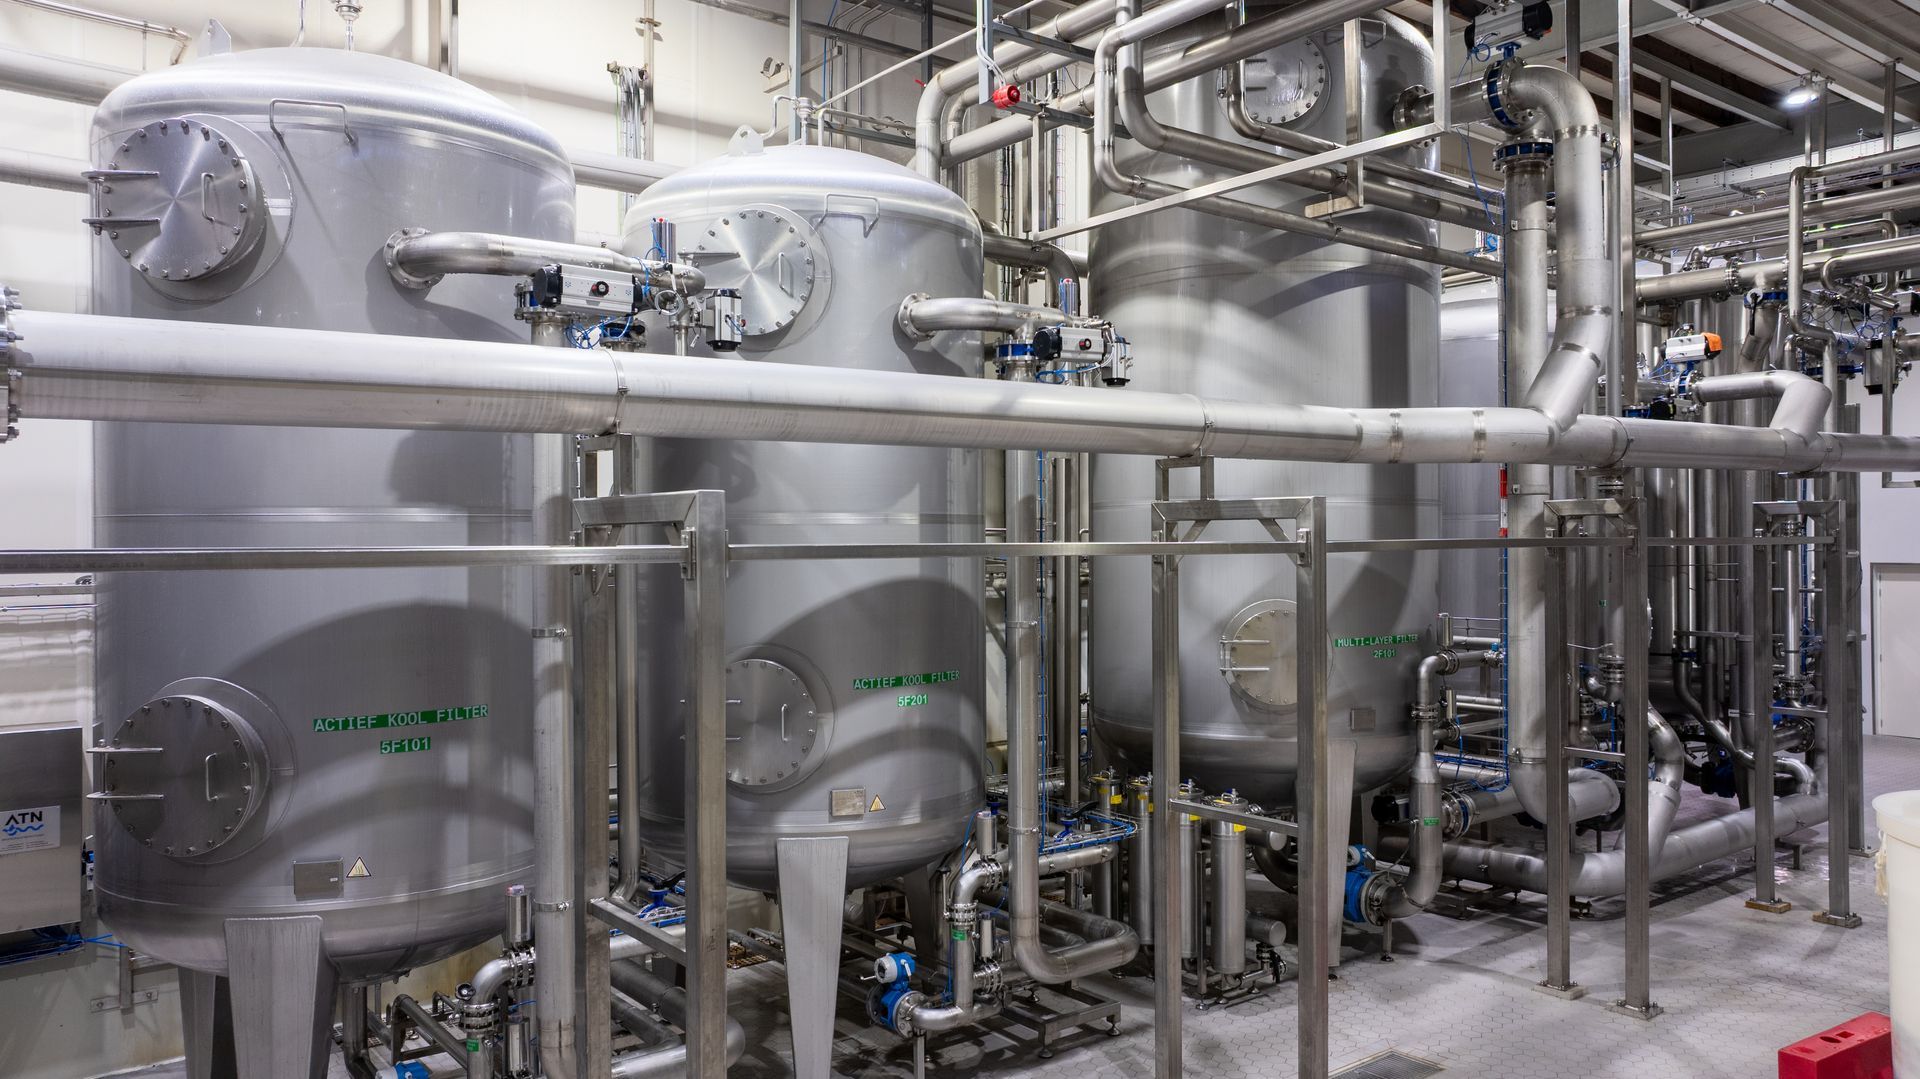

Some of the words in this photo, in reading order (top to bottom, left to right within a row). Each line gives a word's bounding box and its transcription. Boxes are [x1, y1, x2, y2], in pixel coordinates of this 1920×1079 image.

[1337, 636, 1393, 647] MULTI-LAYER
[1373, 649, 1395, 658] 2F101
[854, 677, 896, 689] ACTIEF
[902, 675, 926, 686] KOOL
[931, 670, 960, 683] FILTER
[898, 694, 928, 707] 5F201
[314, 715, 377, 732] ACTIEF
[388, 712, 427, 727] KOOL
[437, 704, 488, 722] FILTER
[381, 738, 429, 754] 5F101
[5, 811, 42, 825] ATN
